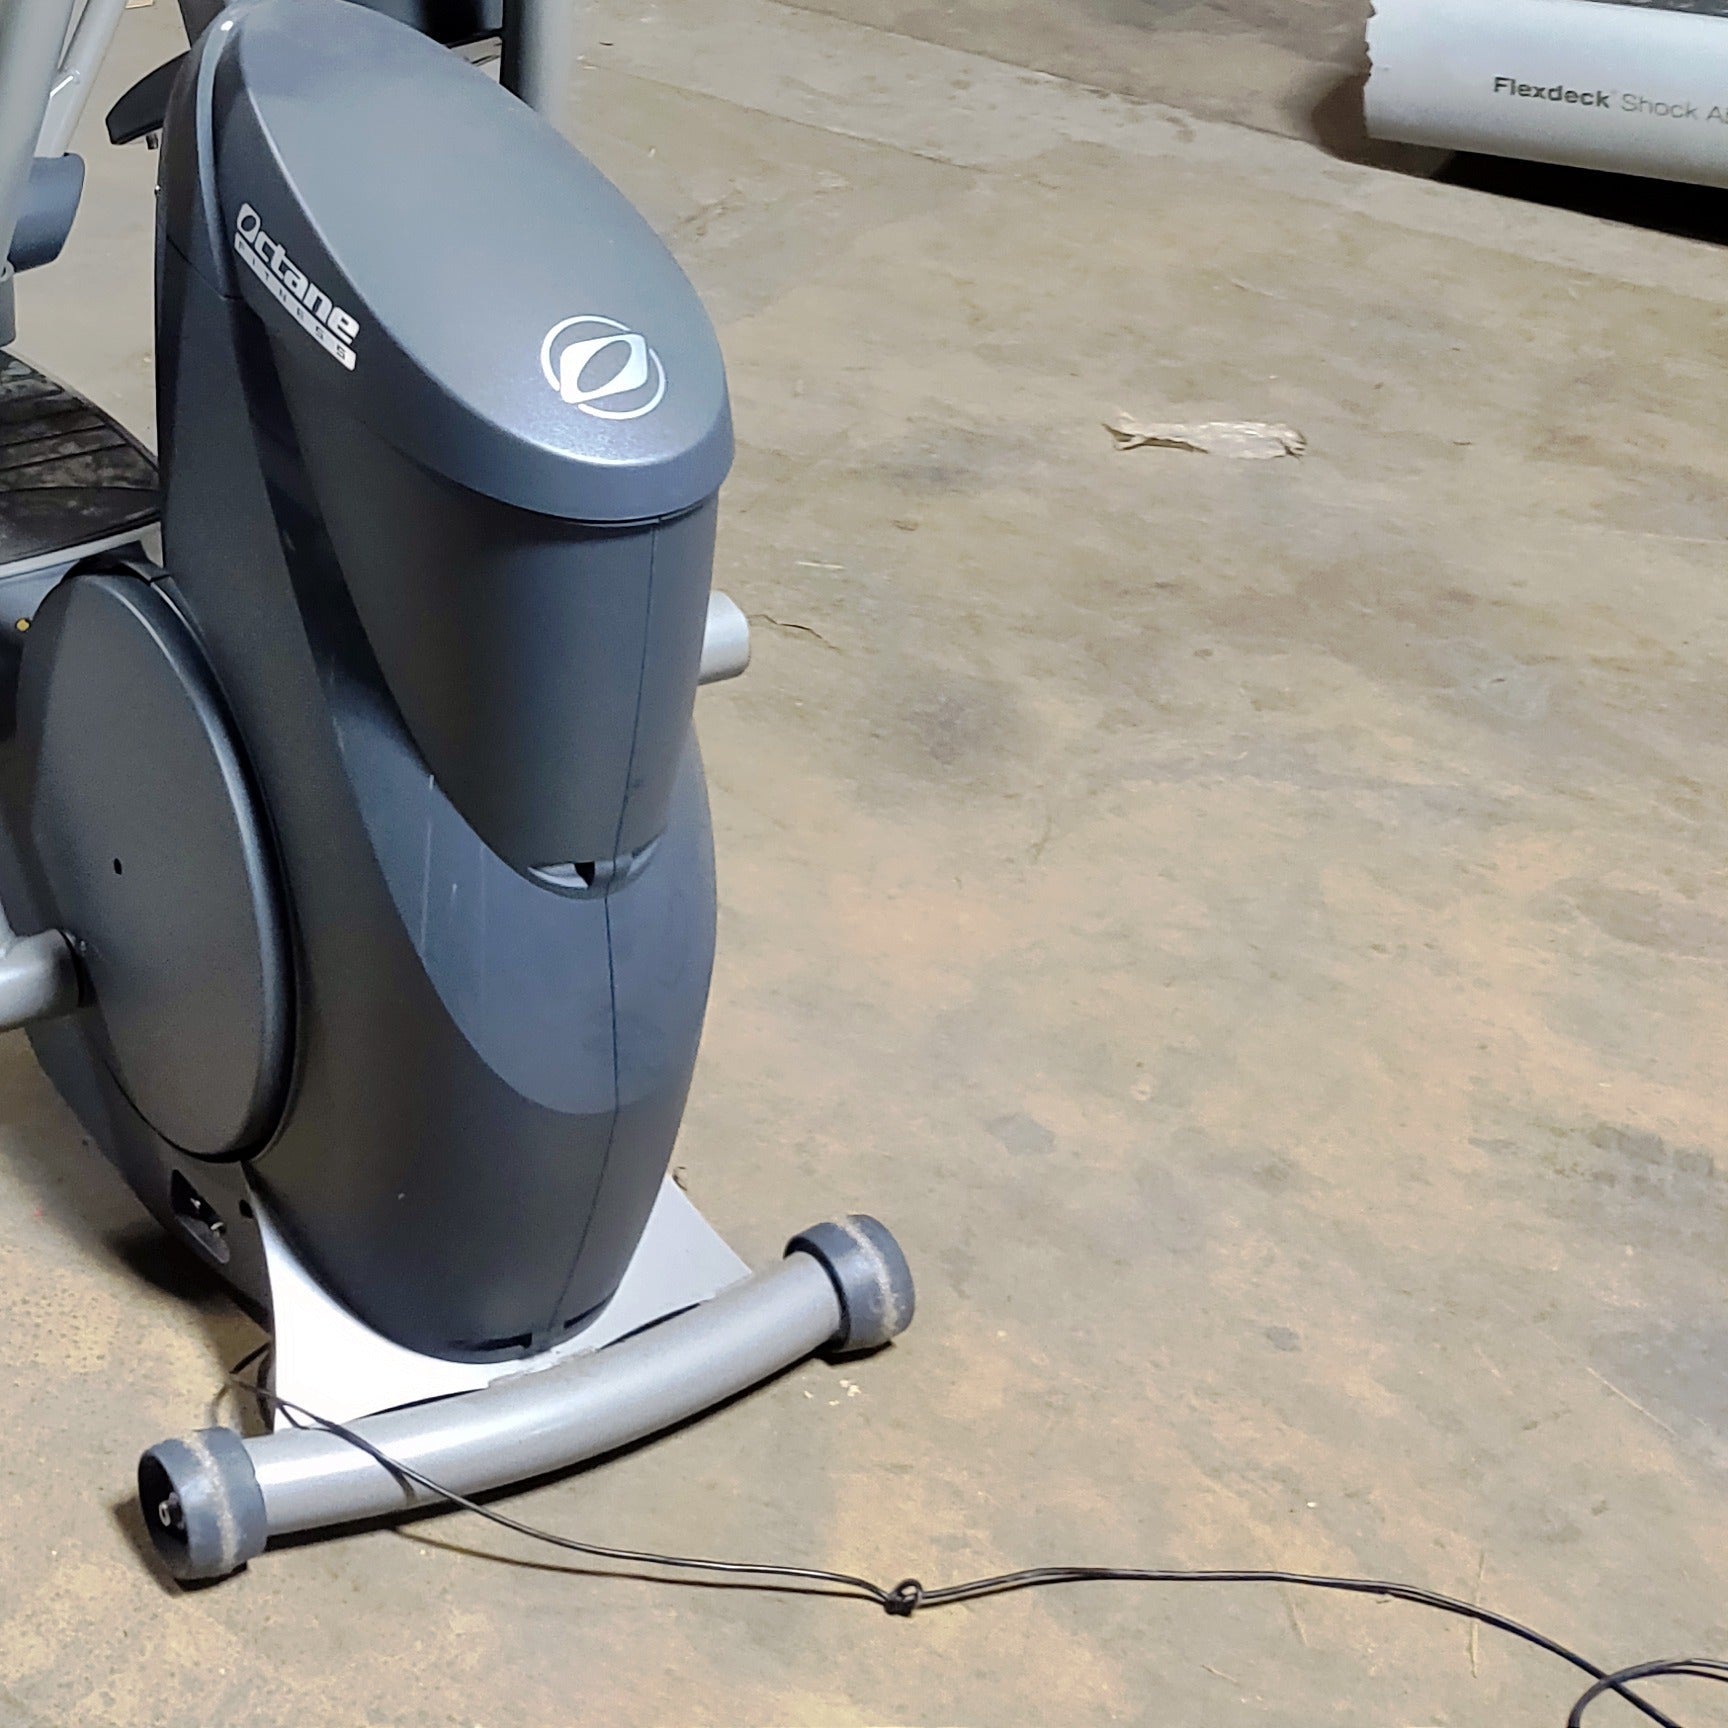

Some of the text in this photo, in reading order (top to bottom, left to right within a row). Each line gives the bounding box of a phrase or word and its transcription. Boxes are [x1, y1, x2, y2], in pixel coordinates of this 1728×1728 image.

[1493, 76, 1610, 109] Flexdeck
[1621, 92, 1698, 121] Shock
[233, 231, 357, 371] FITNESS
[235, 202, 361, 346] Octane
